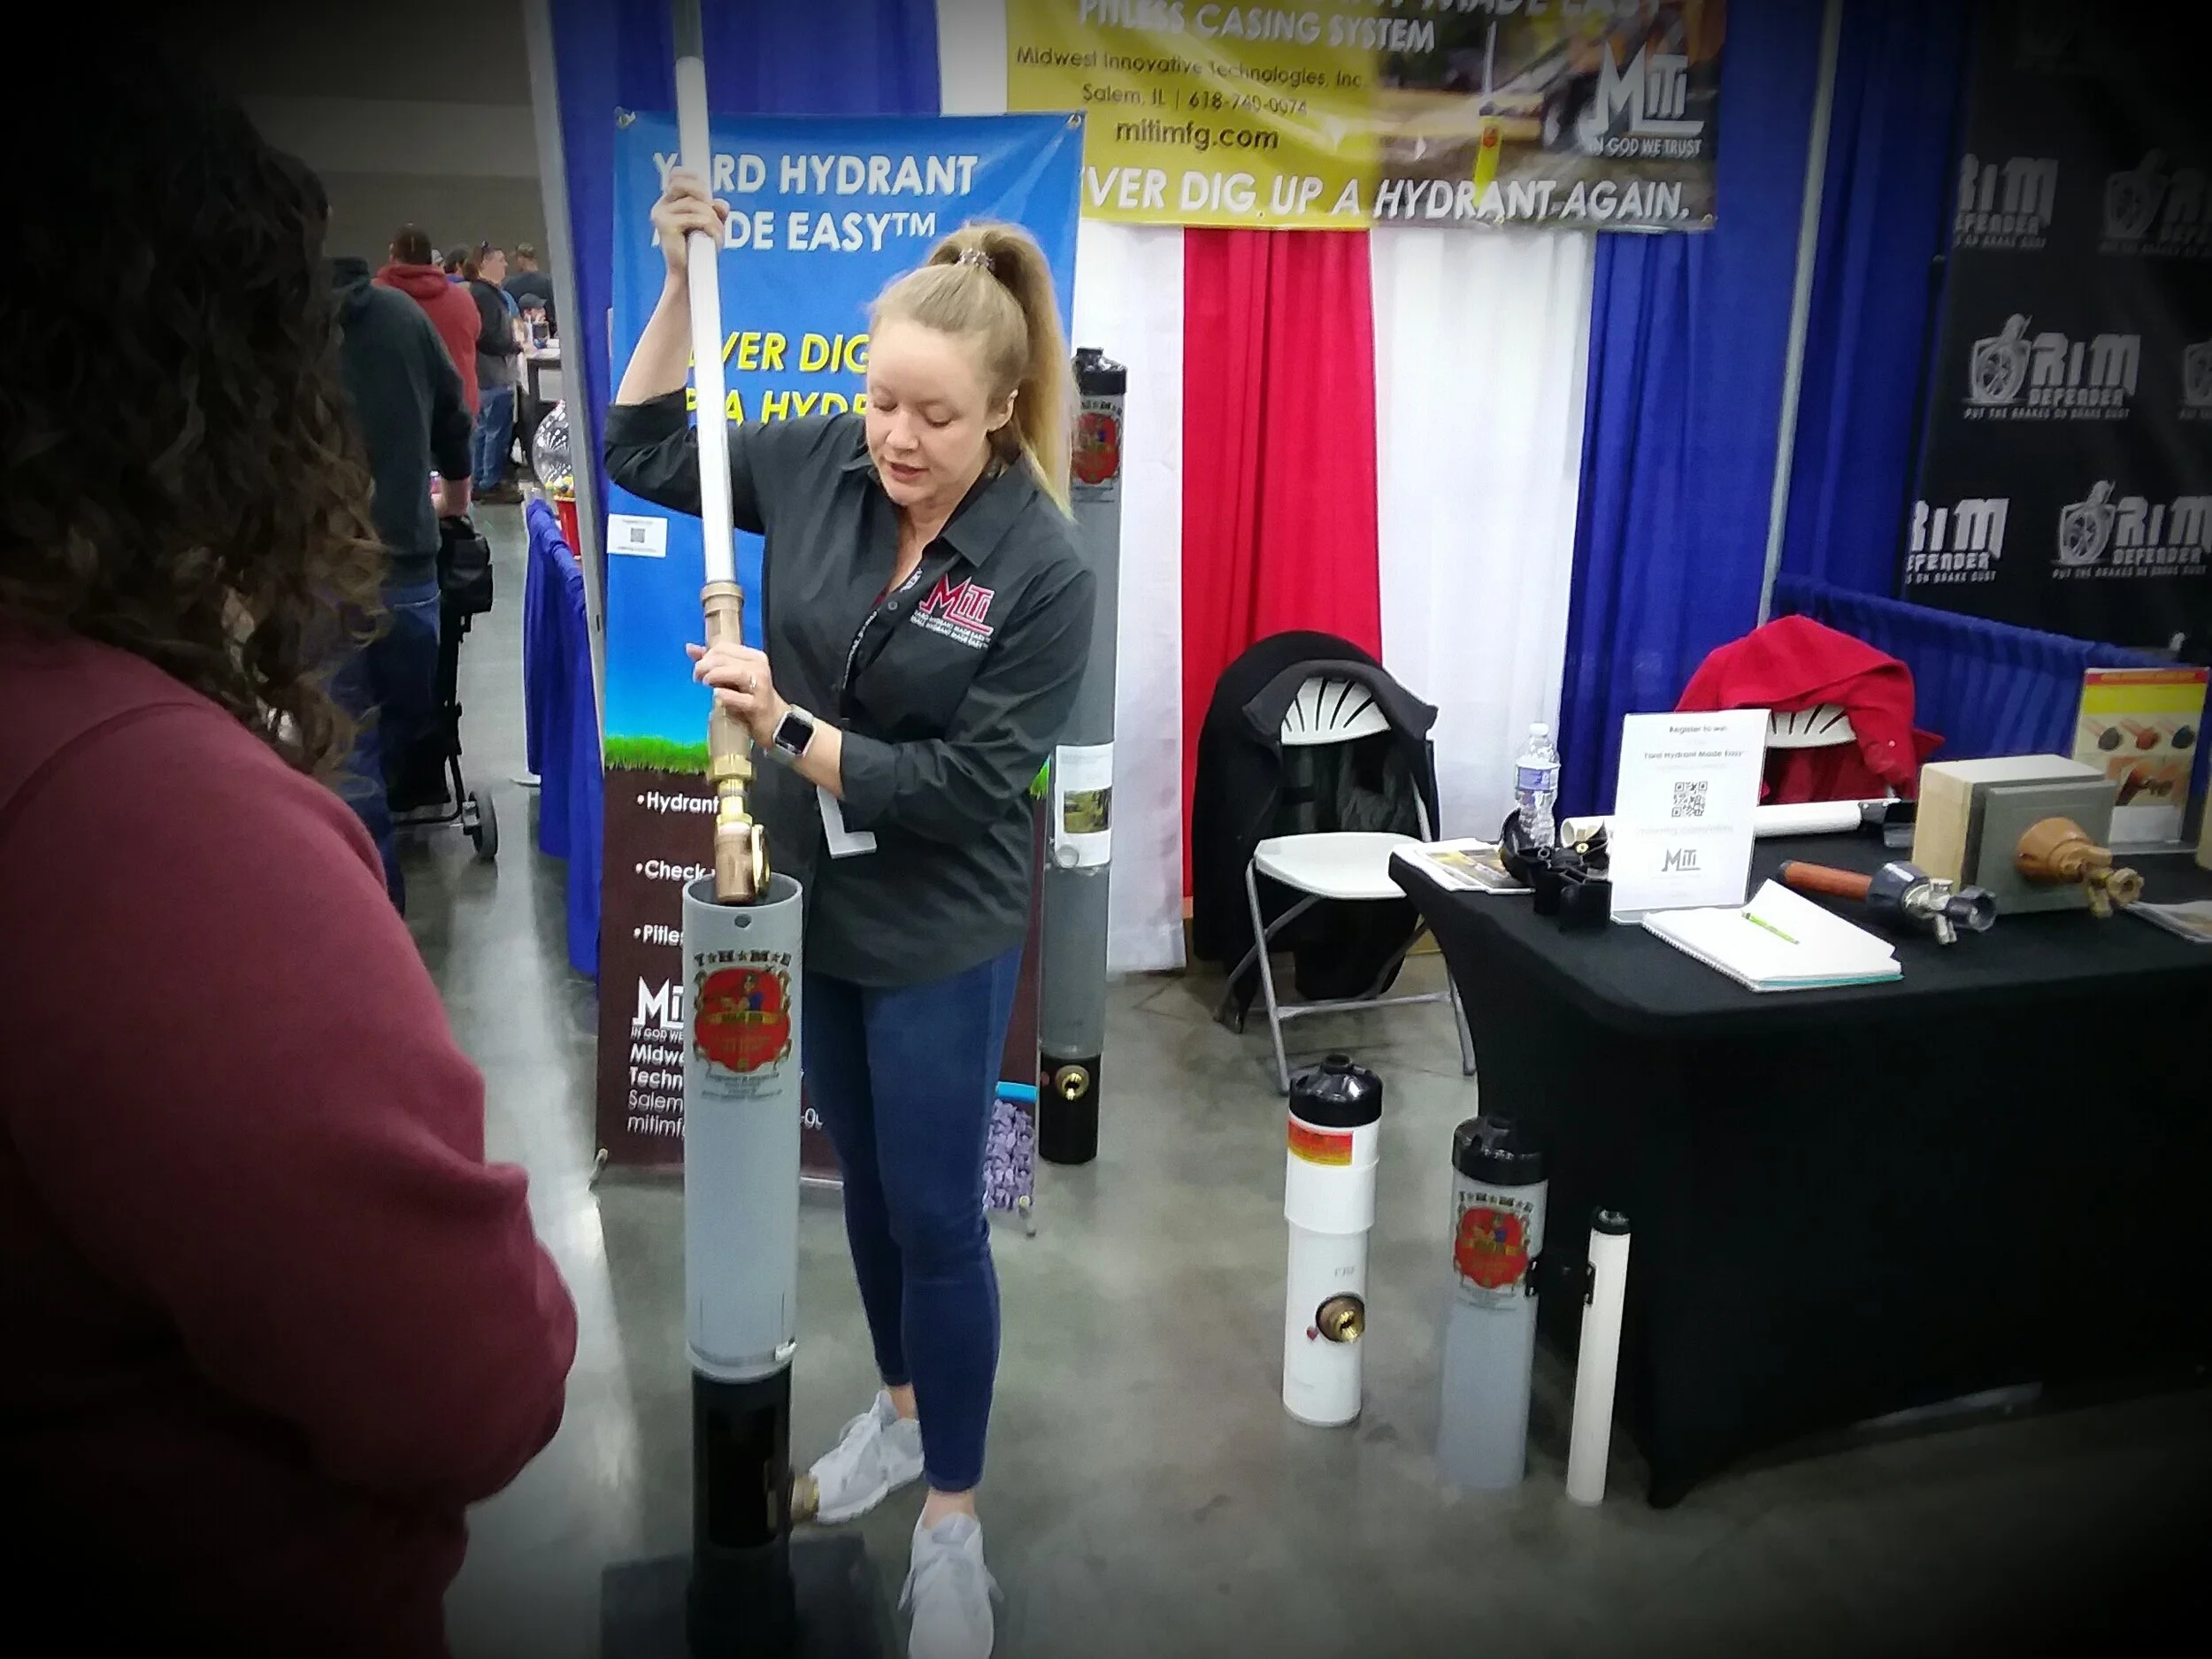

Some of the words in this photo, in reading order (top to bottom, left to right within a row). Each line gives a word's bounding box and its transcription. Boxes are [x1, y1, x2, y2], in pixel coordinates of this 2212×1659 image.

[1194, 4, 1320, 42] CASING
[1328, 13, 1435, 53] SYSTEM
[1017, 46, 1097, 68] Midwest
[1104, 55, 1202, 76] Innovative
[1082, 84, 1145, 105] Salem,
[1152, 89, 1165, 105] IL
[1188, 90, 1308, 116] 618-740-0074
[1116, 118, 1279, 150] mitimfg.com
[1606, 137, 1639, 157] GOD
[1641, 138, 1662, 157] WE
[1664, 139, 1702, 157] TRUST
[652, 151, 766, 193] YRD
[779, 154, 978, 196] HYDRANT
[1082, 165, 1166, 211] VER
[1180, 172, 1257, 214] DIG
[1270, 174, 1323, 215] UP
[1331, 178, 1360, 217] A
[1372, 179, 1557, 220] HYDRANT
[1561, 180, 1690, 221] AGAIN.
[2032, 332, 2141, 396] RIM
[1907, 552, 1990, 572] EFENDER
[646, 790, 718, 814] Hydrant
[644, 859, 706, 881] Check
[643, 1027, 667, 1042] GOD
